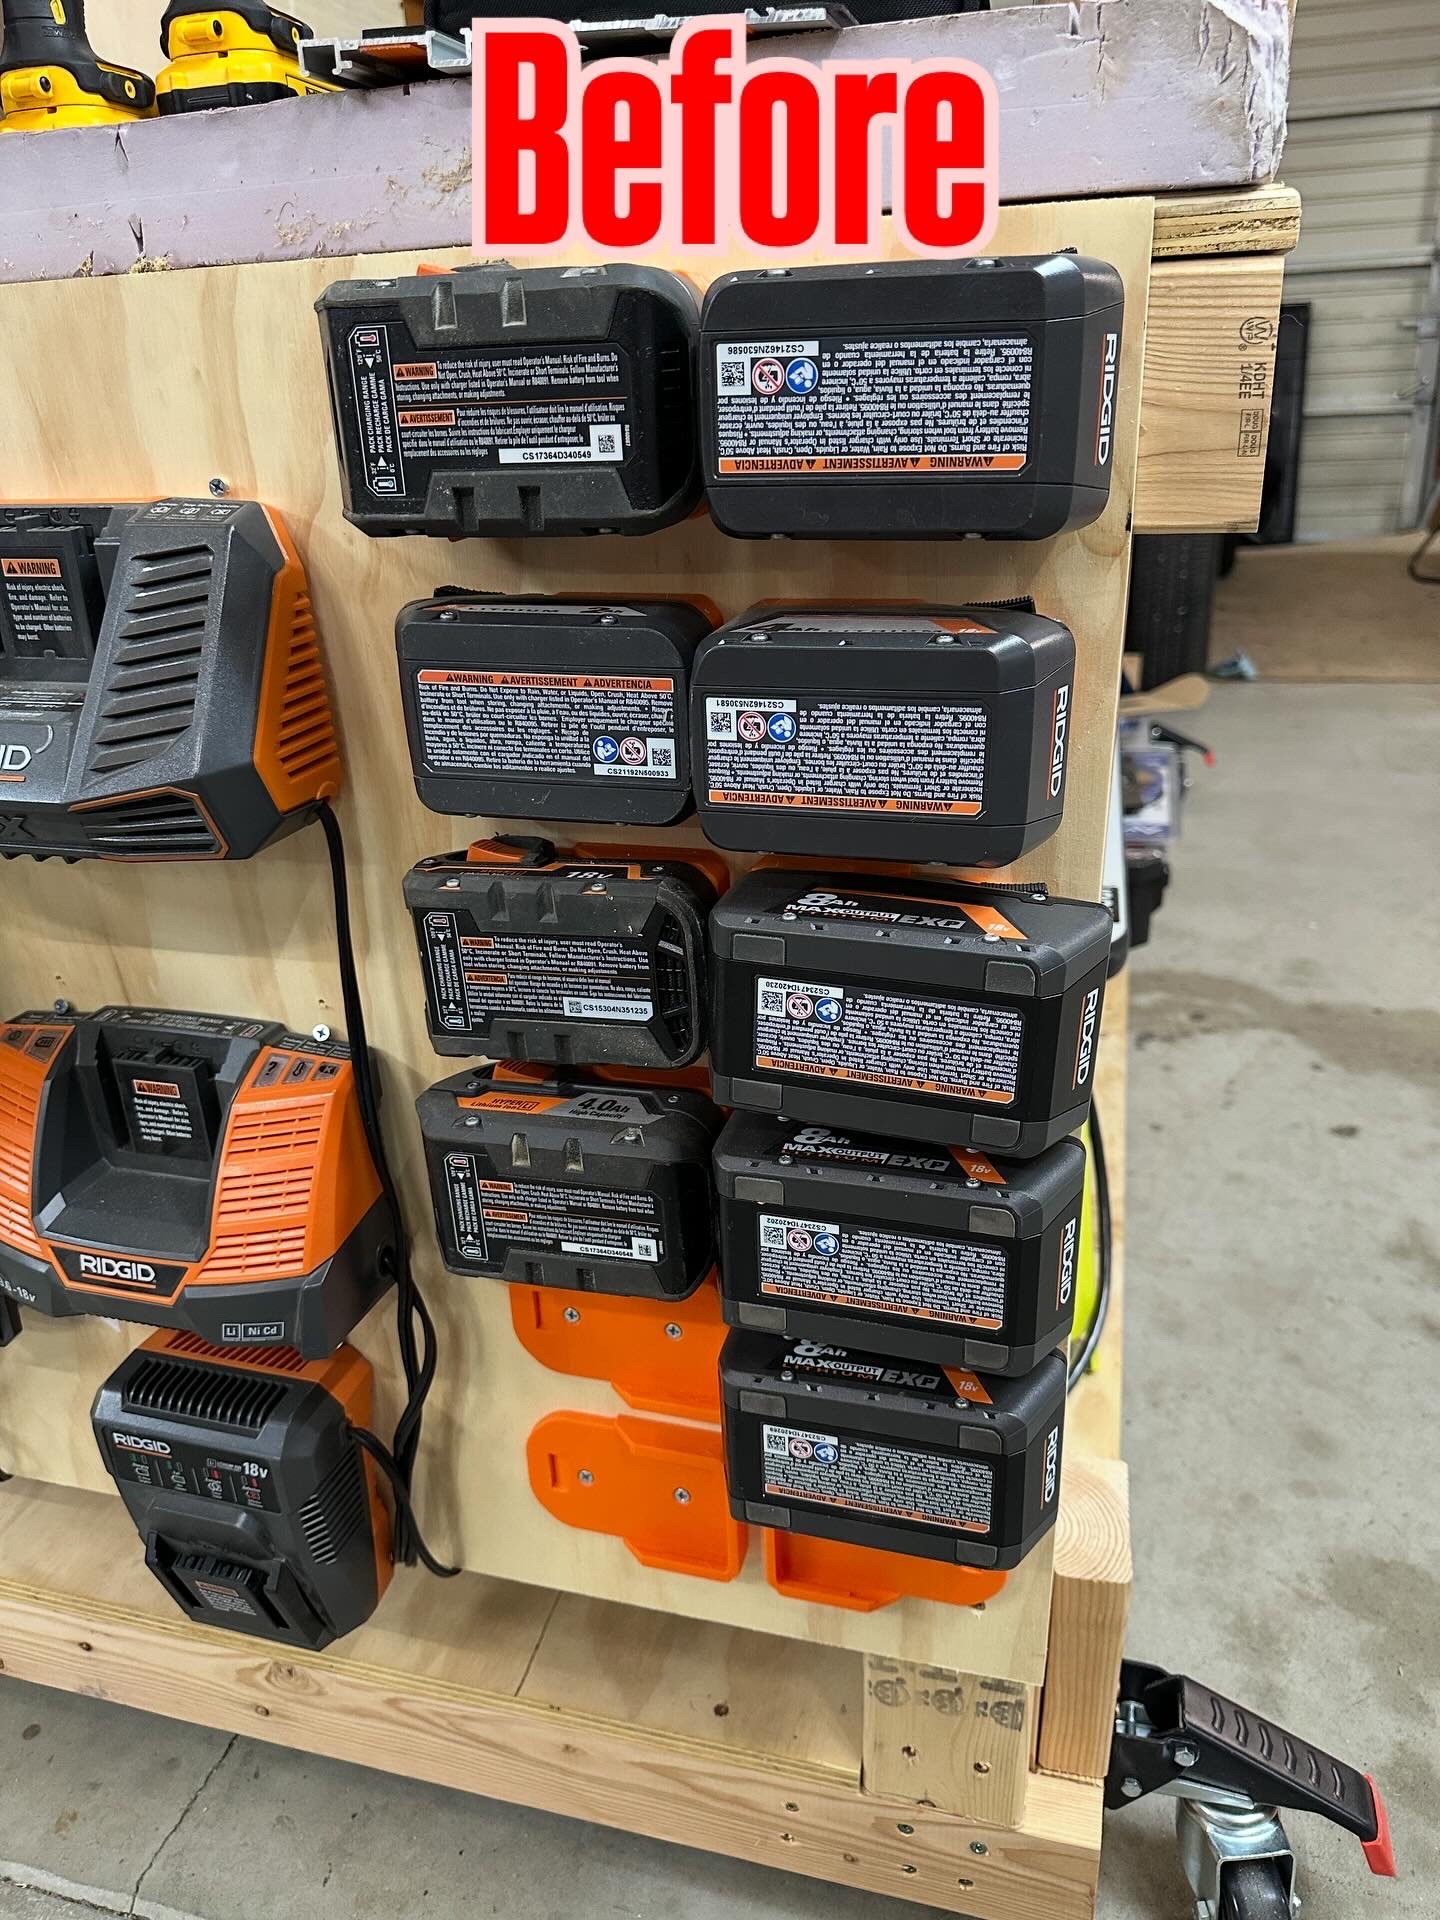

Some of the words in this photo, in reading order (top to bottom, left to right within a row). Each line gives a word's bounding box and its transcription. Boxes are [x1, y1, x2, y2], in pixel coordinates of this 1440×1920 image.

[728, 344, 804, 355] CS21462N530586
[405, 366, 434, 377] WARNING
[369, 372, 379, 399] GAMME
[1252, 361, 1267, 399] KDHT
[361, 375, 370, 400] RANGE
[379, 379, 387, 401] GAMA
[1098, 333, 1117, 466] RIDGID
[364, 400, 375, 435] CHARGING
[372, 399, 383, 435] RECHARGE
[381, 401, 390, 426] CARGA
[410, 413, 453, 423] AVERTISSEMENT
[367, 436, 376, 453] PACK
[376, 436, 385, 453] PACK
[385, 436, 393, 453] PACK
[772, 446, 793, 455] Crush,
[795, 445, 812, 454] Open,
[849, 445, 870, 454] Water,
[871, 445, 888, 454] Rain,
[890, 445, 897, 453] to
[898, 443, 923, 453] Expose
[925, 444, 936, 453] Not
[938, 444, 947, 453] Do
[949, 444, 971, 453] Burns.
[972, 444, 986, 452] and
[987, 444, 1001, 452] Fire
[1002, 444, 1010, 452] of
[1011, 444, 1028, 452] Risk
[522, 451, 592, 460] CS17364D340549
[735, 447, 755, 456] Above
[756, 447, 771, 455] Heat
[735, 459, 804, 471] ADVERTENCIA
[823, 457, 908, 469] AVERTISSEMENT
[930, 456, 983, 468] WARNING
[18, 562, 56, 574] WARNING
[453, 674, 494, 684] WARNING
[510, 676, 578, 687] AVERTISSEMENT
[594, 678, 652, 690] ADVERTENCIA
[1050, 684, 1069, 797] RIDGID
[722, 792, 784, 804] ADVERTENCIA
[801, 796, 877, 808] AVERTISSEMENT
[895, 800, 943, 811] WARNING
[470, 938, 493, 947] WARNING
[1077, 987, 1099, 1085] RIDGID
[771, 1058, 826, 1075] ADVERTENCIA
[846, 1069, 913, 1089] AVERTISSEMENT
[935, 1083, 976, 1096] WARNING
[578, 1098, 630, 1114] 4.0Ah
[569, 1108, 588, 1117] High
[589, 1110, 625, 1119] Capacity
[489, 1182, 512, 1191] WARNING
[1060, 1217, 1076, 1304] RIDGID
[80, 1253, 156, 1282] RIDGID
[776, 1286, 827, 1301] ADVERTENCIA
[845, 1297, 909, 1314] AVERTISSEMENT
[929, 1310, 967, 1323] WARNING
[226, 1326, 236, 1336] Li
[249, 1326, 261, 1336] Ni
[263, 1325, 277, 1335] Cd
[112, 1432, 171, 1454] RIDGID
[242, 1461, 268, 1479] 18v
[1045, 1425, 1059, 1503] RIDGID
[779, 1487, 827, 1502] ADVERTENCIA
[845, 1500, 902, 1516] AVERTISSEMENT
[922, 1514, 957, 1527] WARNING
